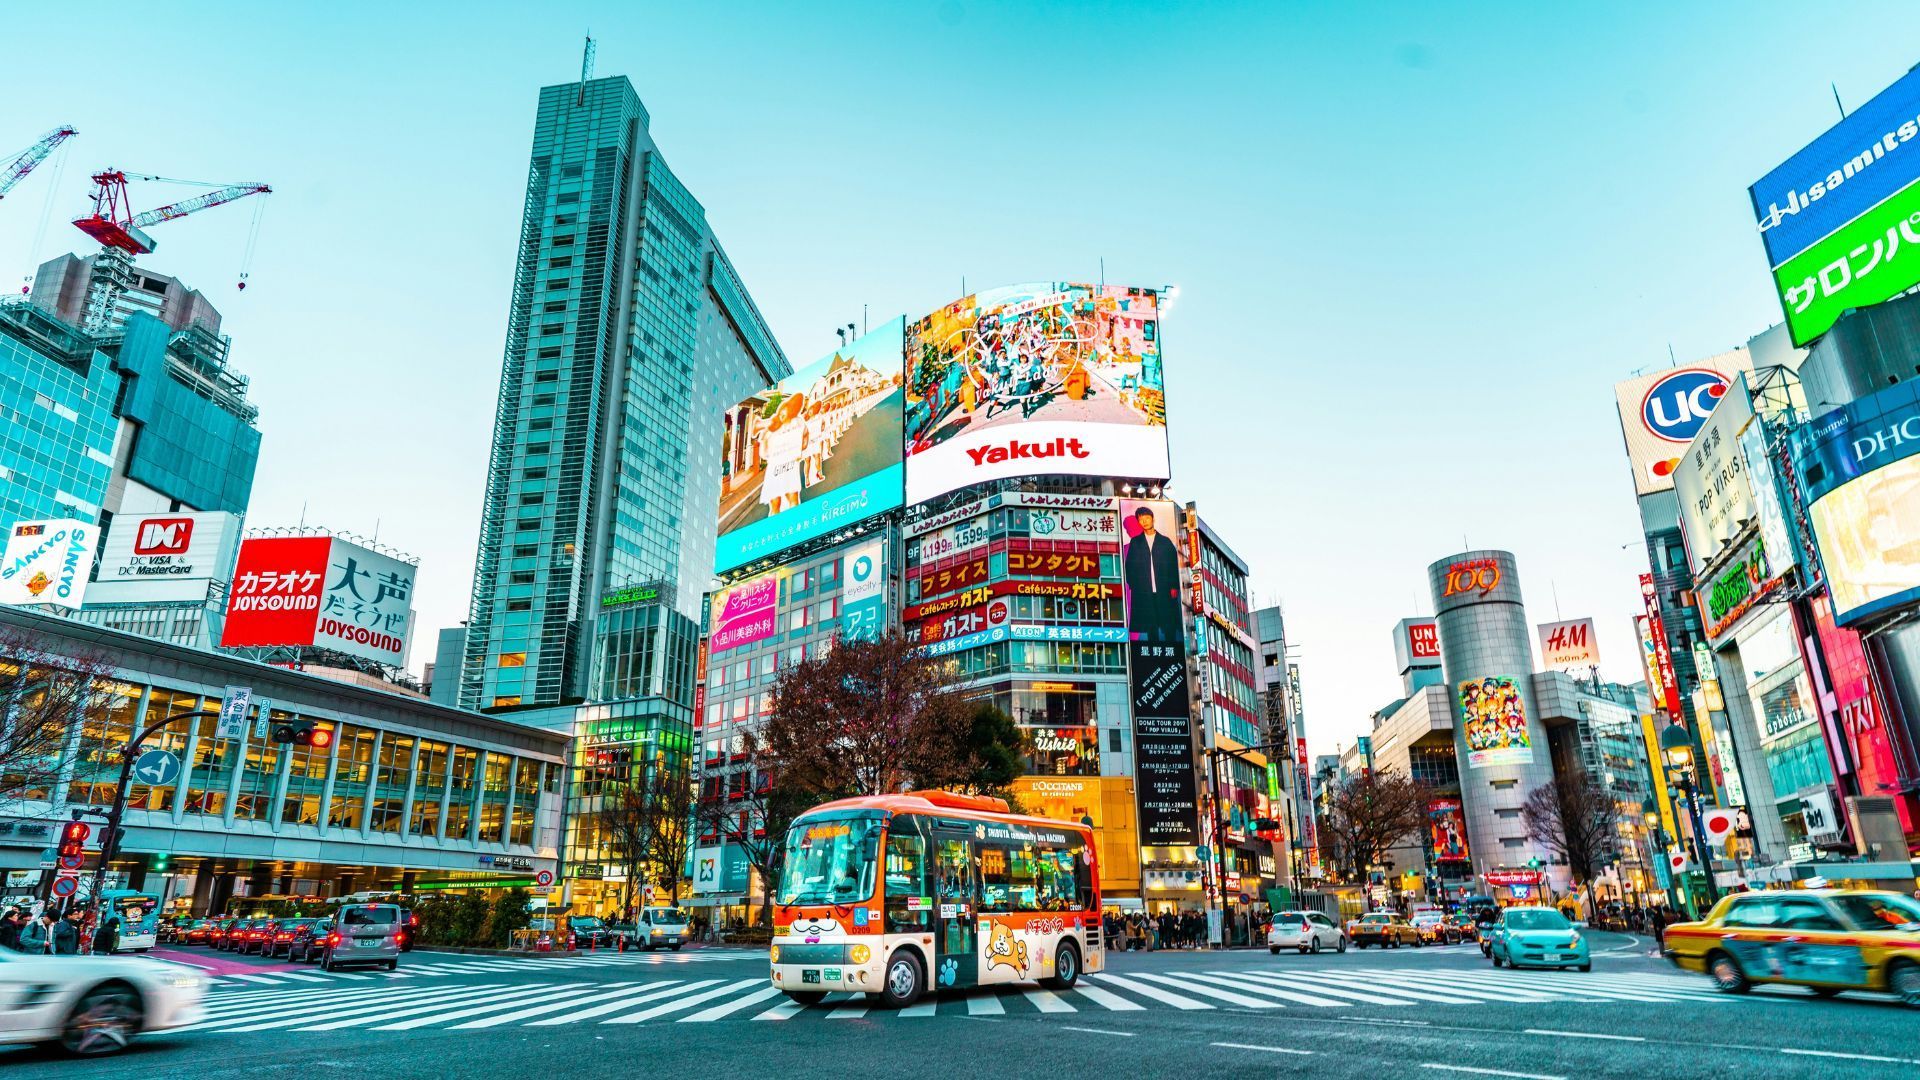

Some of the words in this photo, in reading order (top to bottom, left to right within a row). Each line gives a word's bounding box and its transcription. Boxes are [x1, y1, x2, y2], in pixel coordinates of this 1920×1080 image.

[1757, 114, 1920, 232] Hisamits
[1811, 414, 1849, 441] Channel
[1696, 425, 1720, 471] 星野源
[1852, 416, 1920, 462] DHC
[966, 438, 1090, 466] Yakult
[822, 496, 868, 522] KIREIMO
[1709, 515, 1720, 531] NOW
[1720, 508, 1727, 520] ON
[1060, 515, 1115, 532] しゃぶ葉
[140, 523, 186, 549] DC
[2, 530, 66, 579] SANKYO
[130, 557, 146, 565] DC
[148, 556, 171, 564] VISA
[907, 546, 920, 558] 9F
[1009, 553, 1096, 572] コンタクト
[57, 529, 87, 598] SANKYO
[119, 567, 134, 575] DC
[136, 565, 192, 575] MasterCard
[237, 570, 321, 594] カラオケ
[328, 557, 411, 604] 大声
[922, 560, 987, 593] プライス
[1442, 566, 1501, 597] 109
[740, 580, 773, 600] 品川スキン
[847, 580, 877, 597] eyecity
[961, 587, 993, 608] ガスト
[1072, 583, 1113, 599] ガスト
[233, 595, 317, 611] JOYSOUND
[740, 594, 769, 610] クリニック
[319, 618, 402, 653] JOYSOUND
[719, 618, 772, 645] 品川美容外科
[907, 629, 920, 643] 7F
[943, 612, 984, 638] ガスト
[1015, 628, 1041, 637] AEON
[1048, 627, 1126, 640] 英会話イーオン
[930, 633, 988, 654] 英会話イーオン
[1547, 623, 1586, 651] H&M
[1141, 646, 1175, 657] 星野源
[1152, 695, 1165, 709] NOW
[1163, 689, 1171, 697] ON
[1169, 675, 1184, 691] SALE!
[228, 691, 247, 735] 渋谷駅前
[582, 734, 617, 744] MARK
[987, 828, 1010, 839] SHIBUYA
[1010, 831, 1037, 843] community
[1037, 832, 1046, 842] bus
[1046, 833, 1066, 844] HACHIKO
[1259, 855, 1276, 874] LUSH
[852, 927, 871, 935] D209
[1025, 916, 1065, 935] ハチ公バス
